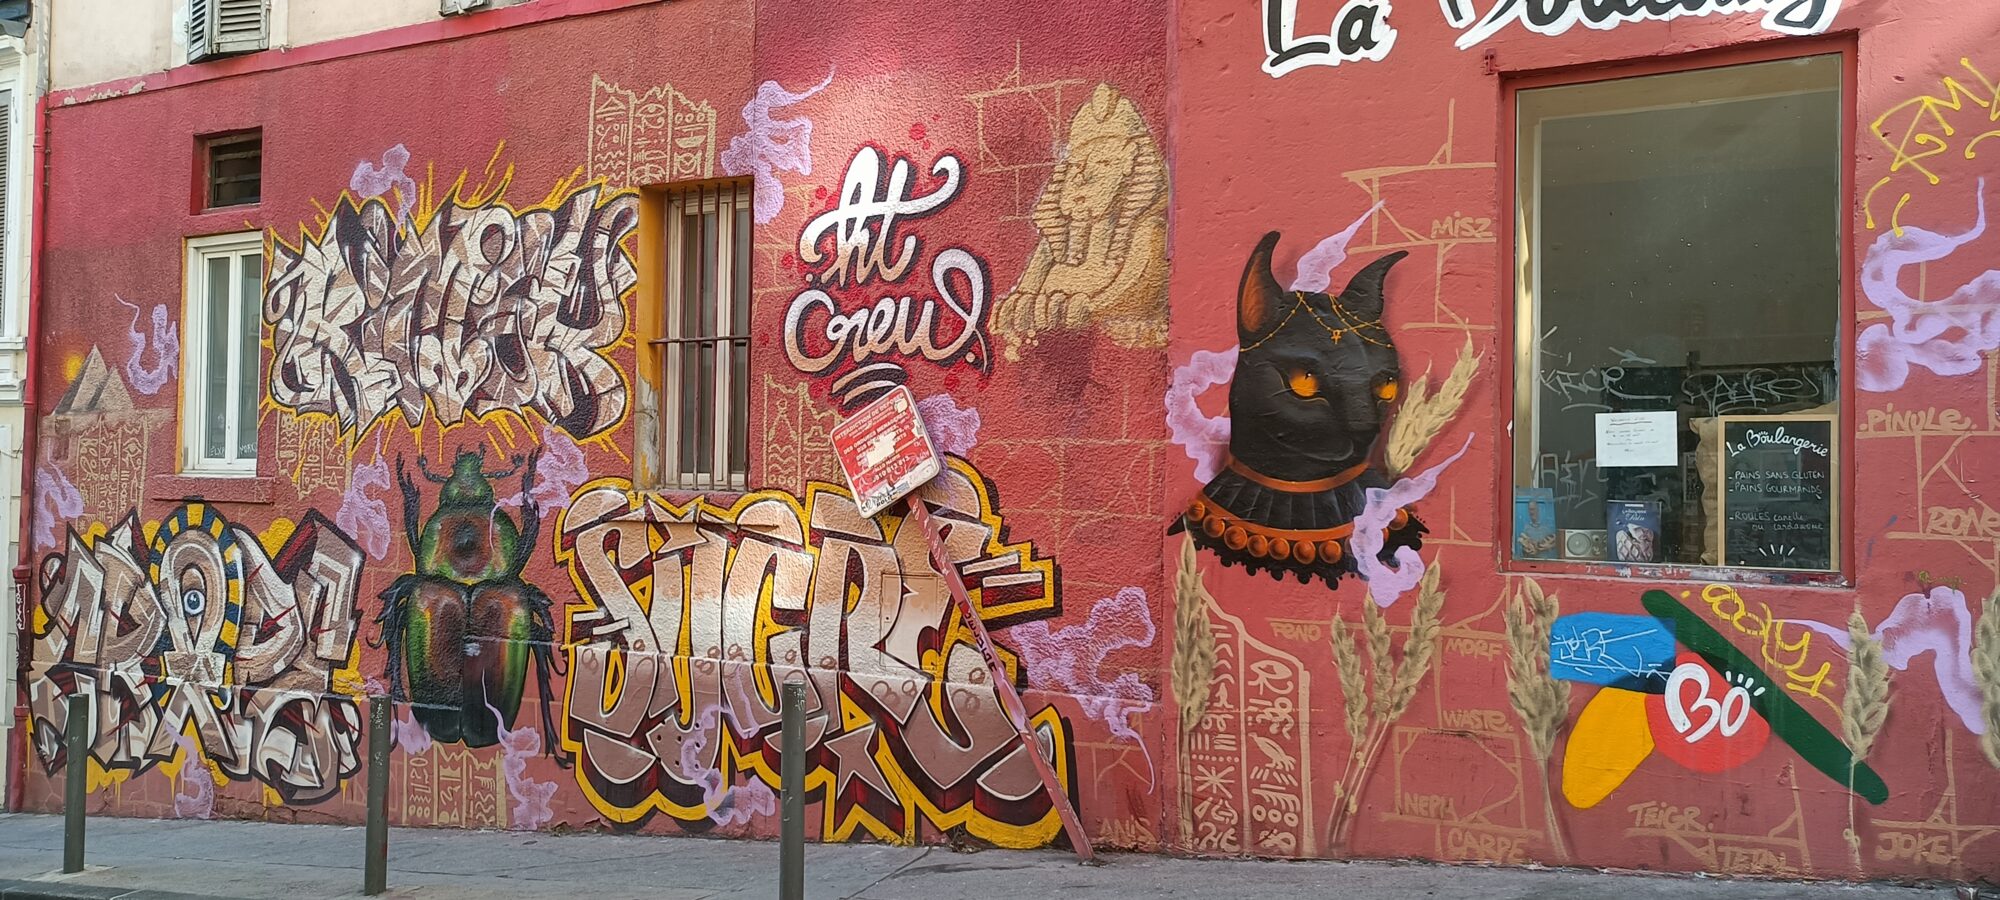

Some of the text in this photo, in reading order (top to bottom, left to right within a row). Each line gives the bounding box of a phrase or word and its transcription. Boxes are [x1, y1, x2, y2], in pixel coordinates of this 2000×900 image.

[1726, 441, 1746, 457] La
[1735, 471, 1760, 479] PAINS
[1765, 471, 1789, 479] SANS
[1791, 470, 1825, 479] GLUTEN
[1735, 483, 1762, 493] PAINS
